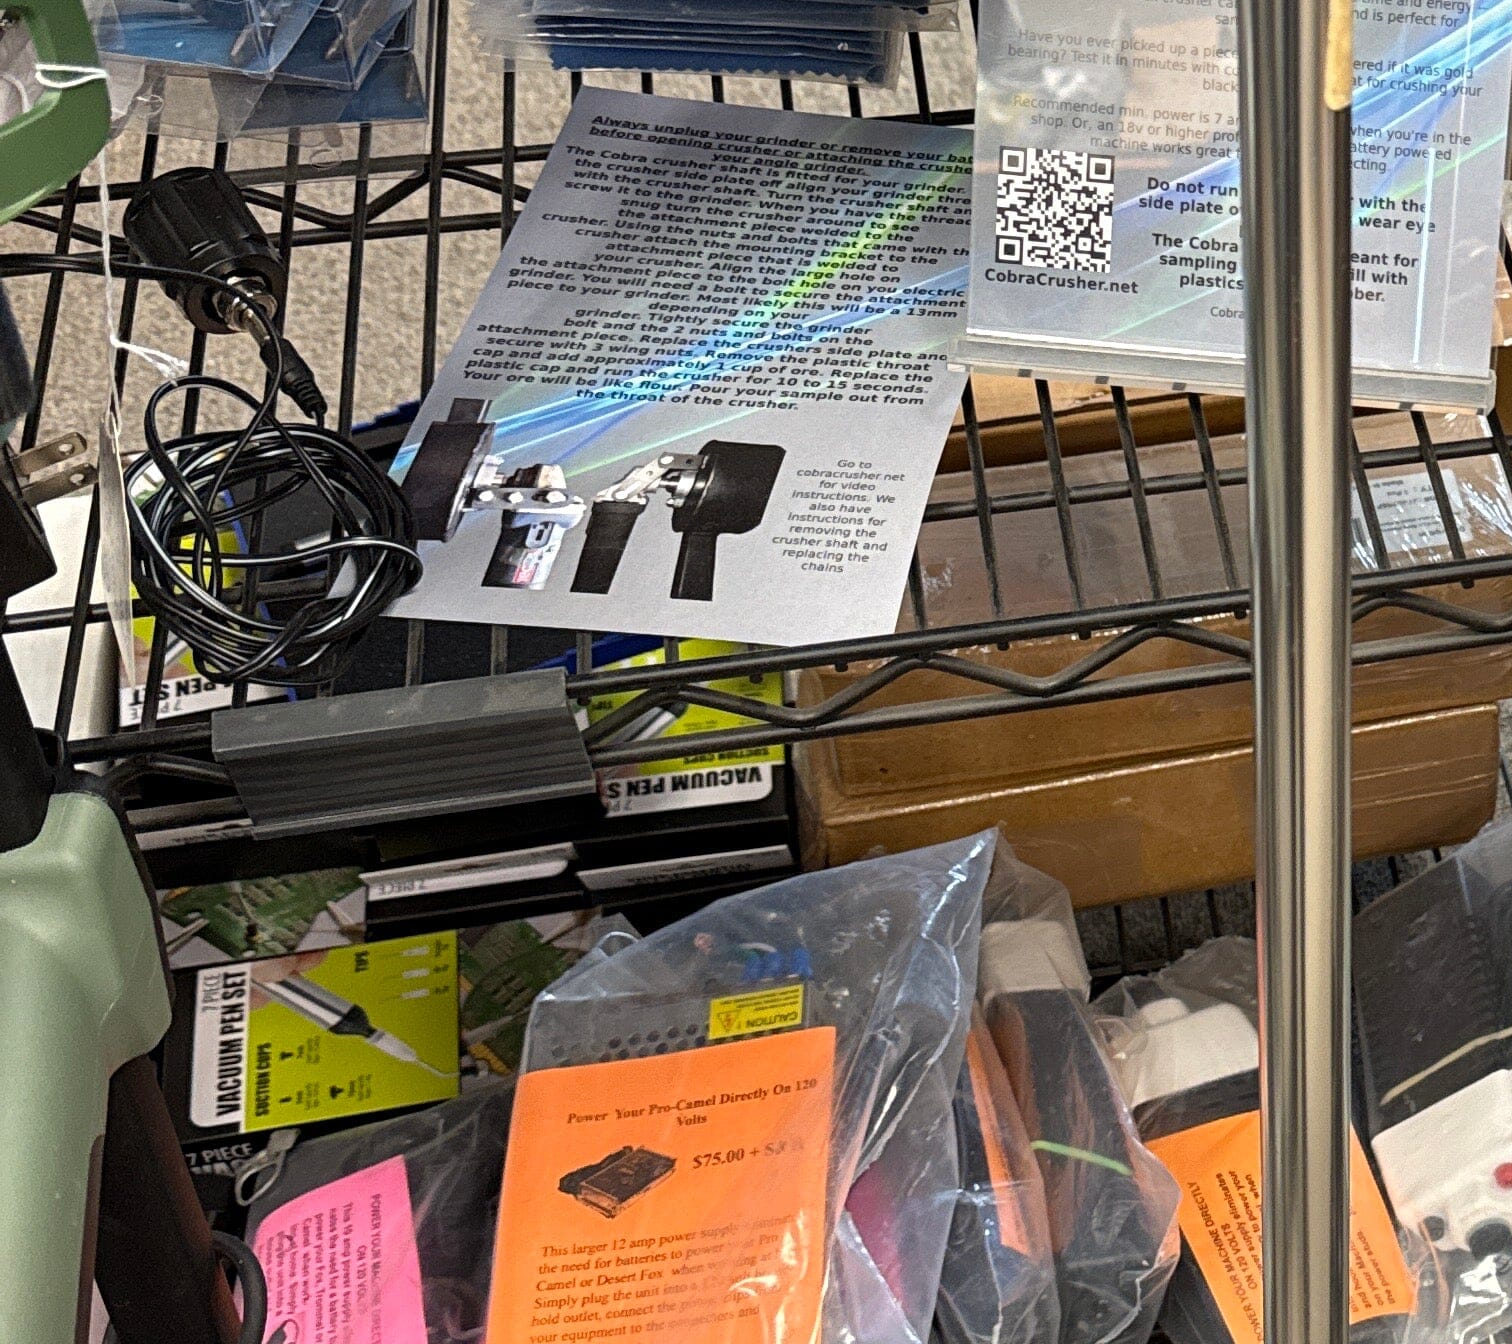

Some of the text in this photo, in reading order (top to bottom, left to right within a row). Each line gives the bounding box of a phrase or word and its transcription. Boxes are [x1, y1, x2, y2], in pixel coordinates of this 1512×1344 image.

[1426, 0, 1472, 14] energy
[1373, 9, 1460, 28] is perfect for
[591, 115, 943, 162] Always unplug your grinder or remove your
[1387, 129, 1472, 146] you're in the
[589, 126, 914, 169] before opening crusher or attaching the
[566, 145, 596, 156] The
[600, 150, 648, 163] Cobra
[652, 158, 717, 171] crusher
[720, 163, 762, 176] shaft
[766, 169, 779, 178] is
[785, 170, 830, 182] fitted
[834, 176, 858, 185] for
[863, 178, 899, 189] your
[1147, 177, 1426, 213] Do not run with the
[1138, 197, 1436, 234] side plate wear eye
[1152, 233, 1419, 268] The Cobra for
[1159, 253, 1408, 286] sampling with
[984, 268, 1139, 294] CobraCrusher.net
[1179, 273, 1244, 290] plastics
[462, 370, 502, 382] Your
[506, 374, 536, 385] ore
[541, 375, 571, 386] will
[575, 377, 598, 387] be
[603, 377, 634, 389] like
[837, 459, 872, 469] Go to
[819, 480, 876, 491] for video
[809, 503, 872, 514] also have
[876, 494, 896, 504] We
[788, 512, 886, 527] instructions for
[789, 526, 877, 538] removing the
[772, 536, 888, 551] crusher shaft and
[782, 549, 870, 562] replacing the
[801, 562, 844, 573] chains
[627, 778, 665, 795] PEN
[672, 767, 763, 792] VACUUM
[746, 1010, 798, 1029] CAUTION
[216, 971, 247, 1117] VACUUM PEN SET
[255, 1042, 271, 1117] SUCTION CUPS
[566, 1078, 817, 1125] Power Your Pro-Camel Directly On 120
[676, 1113, 707, 1128] Volts
[692, 1148, 745, 1170] $75.00
[1187, 1181, 1235, 1272] MACHINE DIRECTLY
[542, 1230, 696, 1258] This larger 12 amp power
[1221, 1223, 1258, 1290] ON 120 VOLTS
